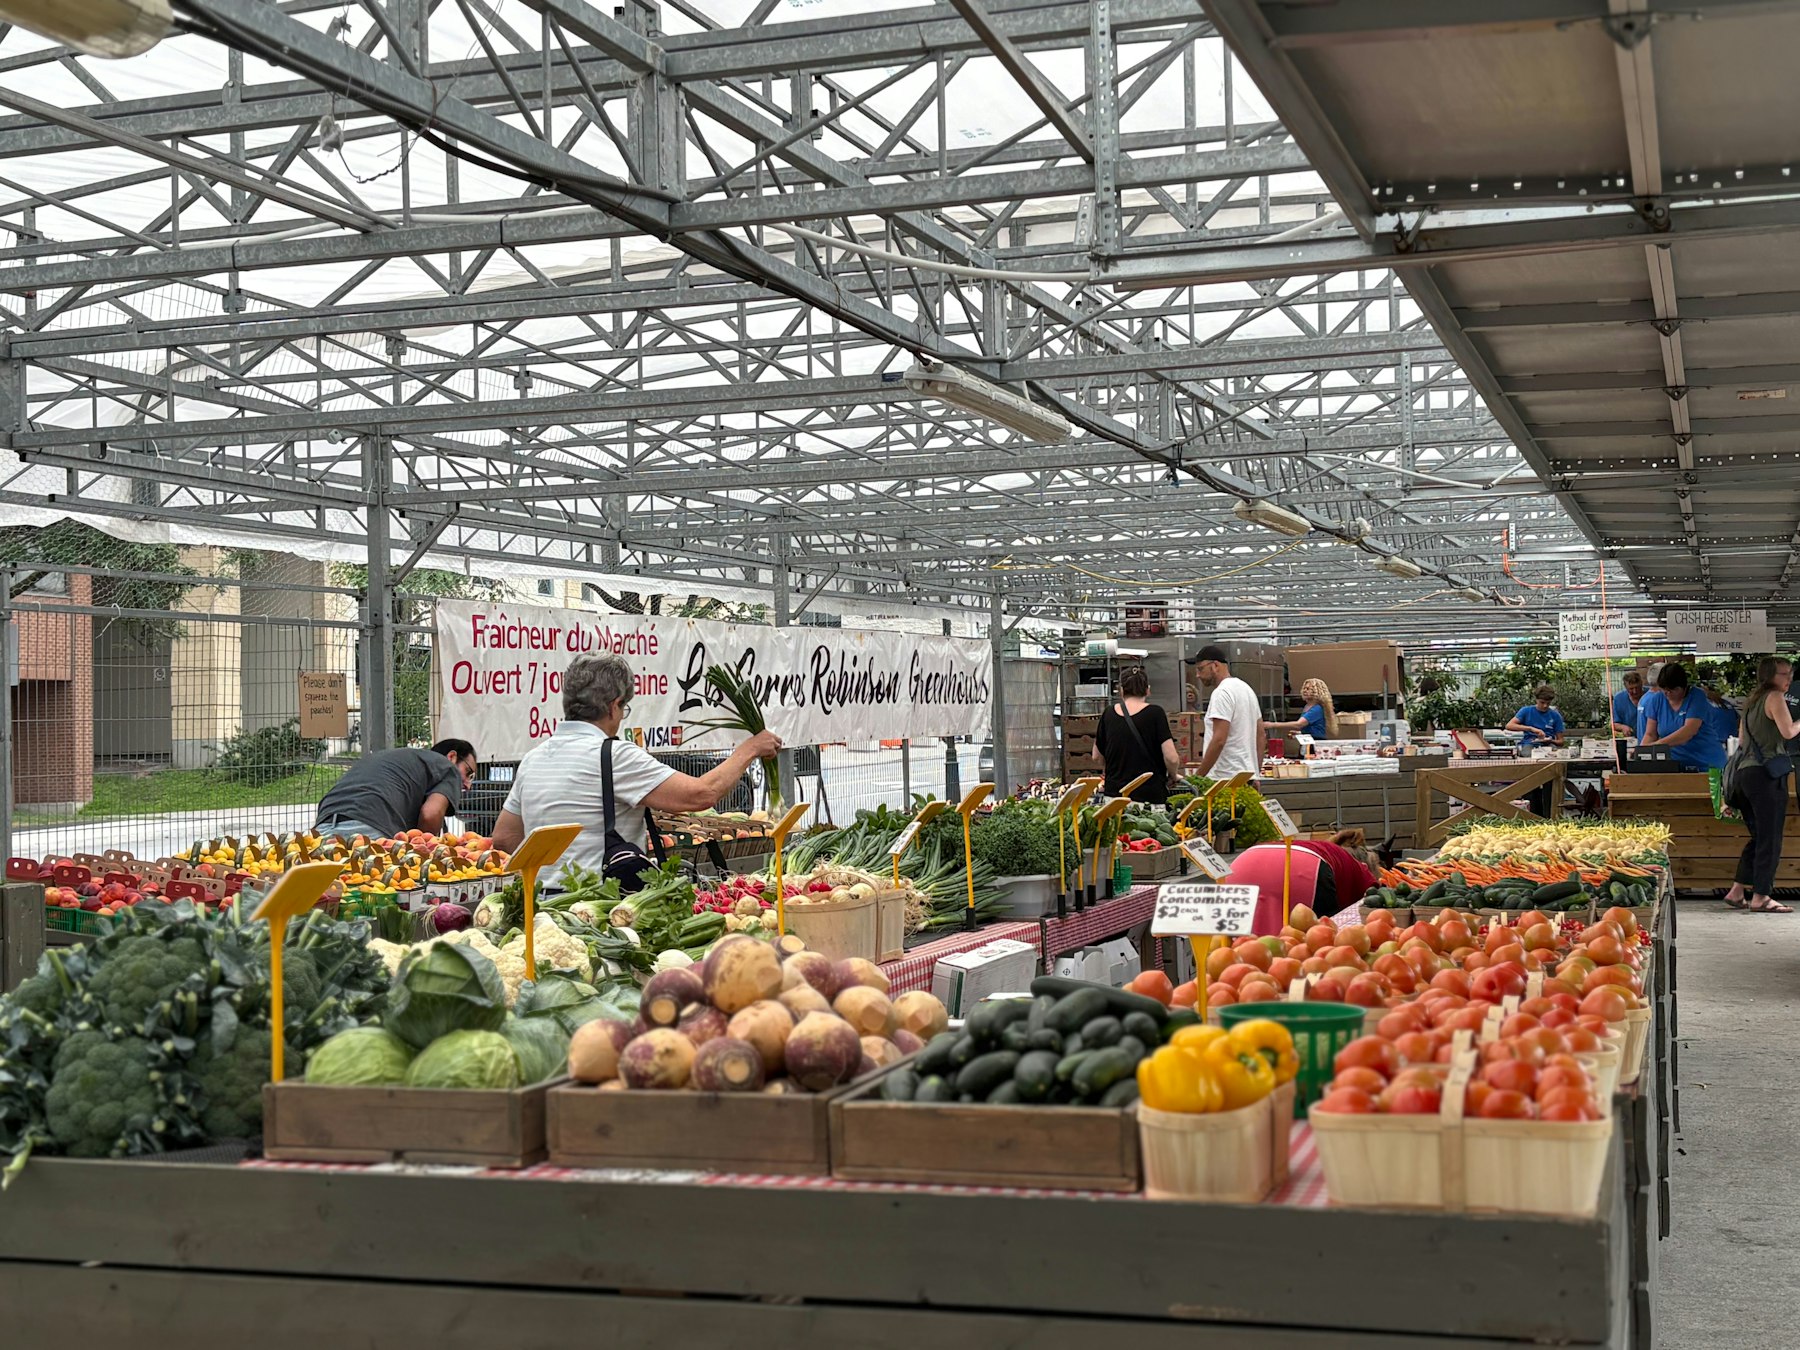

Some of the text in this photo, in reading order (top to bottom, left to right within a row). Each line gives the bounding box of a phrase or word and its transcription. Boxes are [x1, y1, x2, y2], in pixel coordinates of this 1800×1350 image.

[1562, 612, 1586, 622] Method
[1589, 612, 1597, 621] of
[1674, 610, 1752, 624] CASH REGISTER
[1570, 622, 1590, 631] CASH
[1696, 624, 1729, 633] PAY HERE
[471, 613, 659, 656] Fraîcheur du Marché
[1570, 633, 1590, 642] Debit
[1729, 641, 1742, 649] HERE
[303, 676, 325, 689] Please
[451, 660, 522, 695] Ouvert
[528, 662, 538, 694] 7
[634, 666, 668, 695] aine
[811, 645, 901, 715] Robinson
[643, 726, 670, 748] VISA
[1167, 885, 1250, 895] Cucumbers
[1159, 895, 1250, 906] Concombres
[1157, 905, 1180, 919] $2
[1211, 908, 1222, 919] 3
[1226, 907, 1249, 918] for
[1215, 919, 1239, 932] $5
